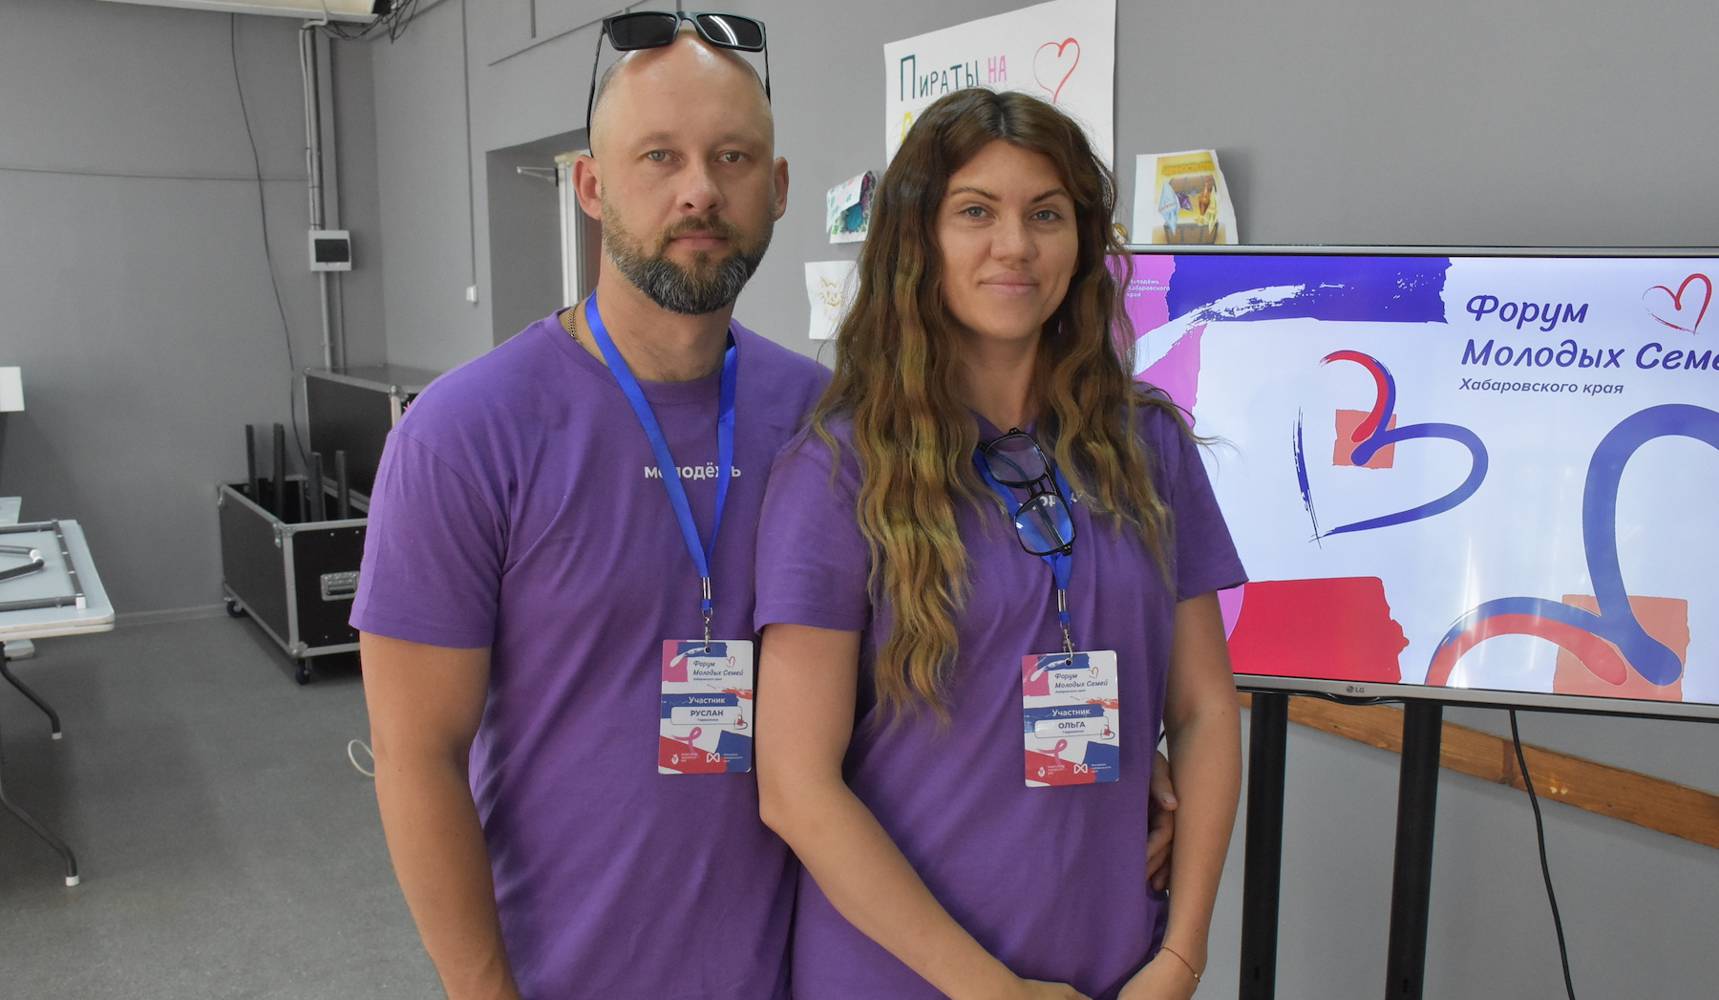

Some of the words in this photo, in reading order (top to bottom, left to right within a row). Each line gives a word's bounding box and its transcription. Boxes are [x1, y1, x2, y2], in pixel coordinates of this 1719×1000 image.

[987, 55, 1007, 84] НА
[1466, 294, 1589, 332] Форум
[1460, 338, 1626, 369] Молодых
[1459, 377, 1579, 395] Хабаровского
[1582, 382, 1625, 396] края
[688, 697, 726, 705] Участник
[1051, 708, 1091, 717] Участник
[1058, 721, 1086, 729] ОЛЬГА
